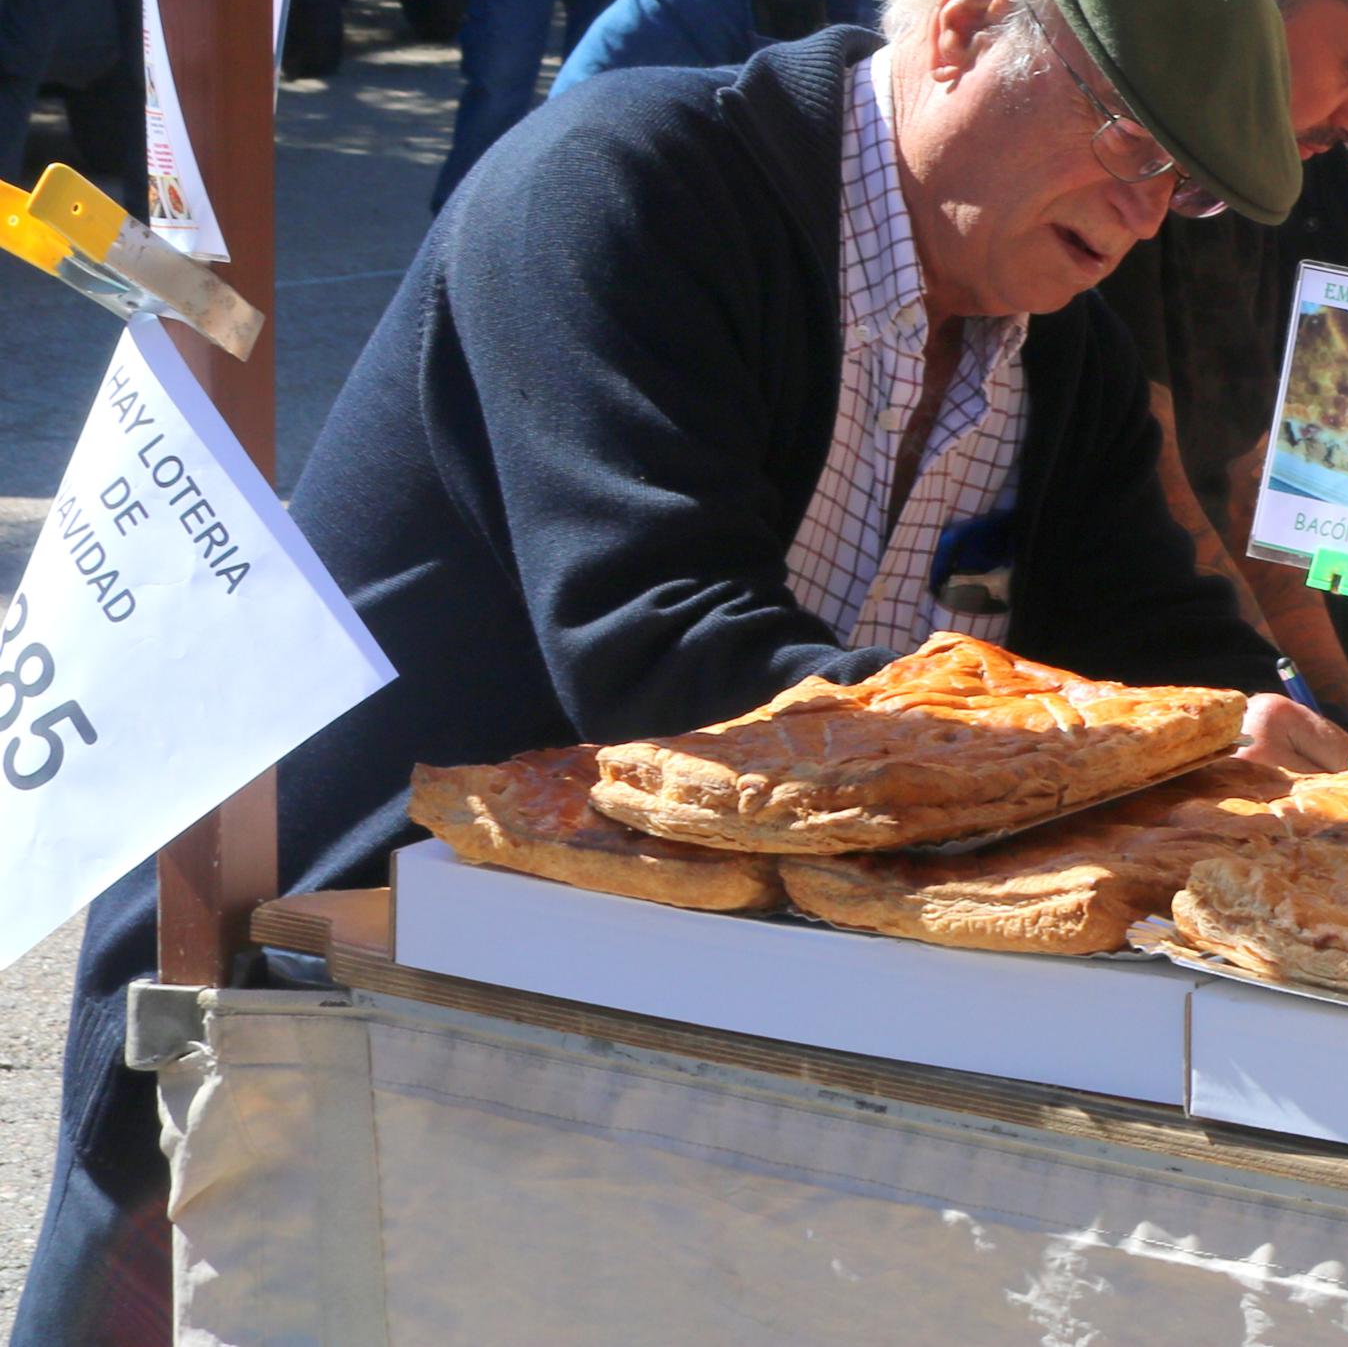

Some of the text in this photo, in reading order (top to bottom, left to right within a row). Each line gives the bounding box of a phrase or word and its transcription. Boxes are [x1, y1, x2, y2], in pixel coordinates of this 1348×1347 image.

[99, 476, 149, 537] DE
[107, 365, 251, 595] HAY LOTERIA
